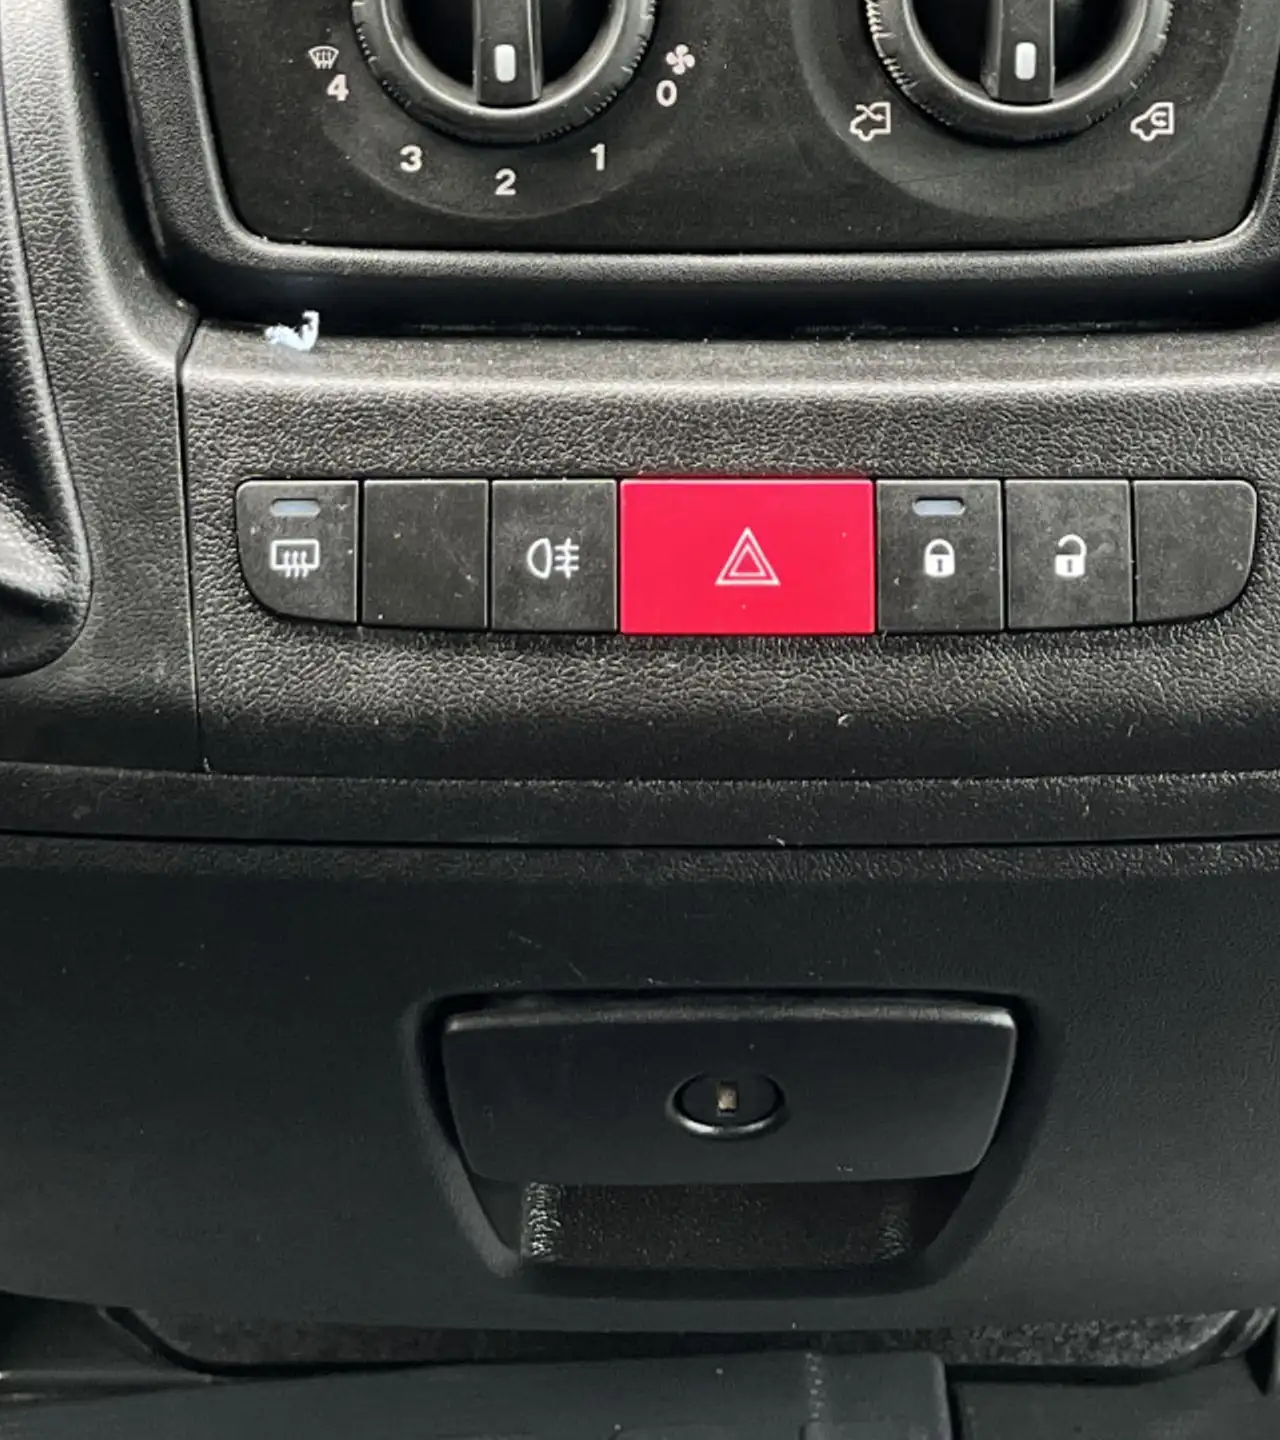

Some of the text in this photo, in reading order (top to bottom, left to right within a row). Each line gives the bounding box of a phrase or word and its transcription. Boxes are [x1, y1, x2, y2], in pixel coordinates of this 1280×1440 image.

[326, 74, 350, 102] 4
[655, 79, 678, 107] 0
[400, 145, 423, 173] 3
[590, 143, 605, 171] 1
[494, 168, 517, 196] 2
